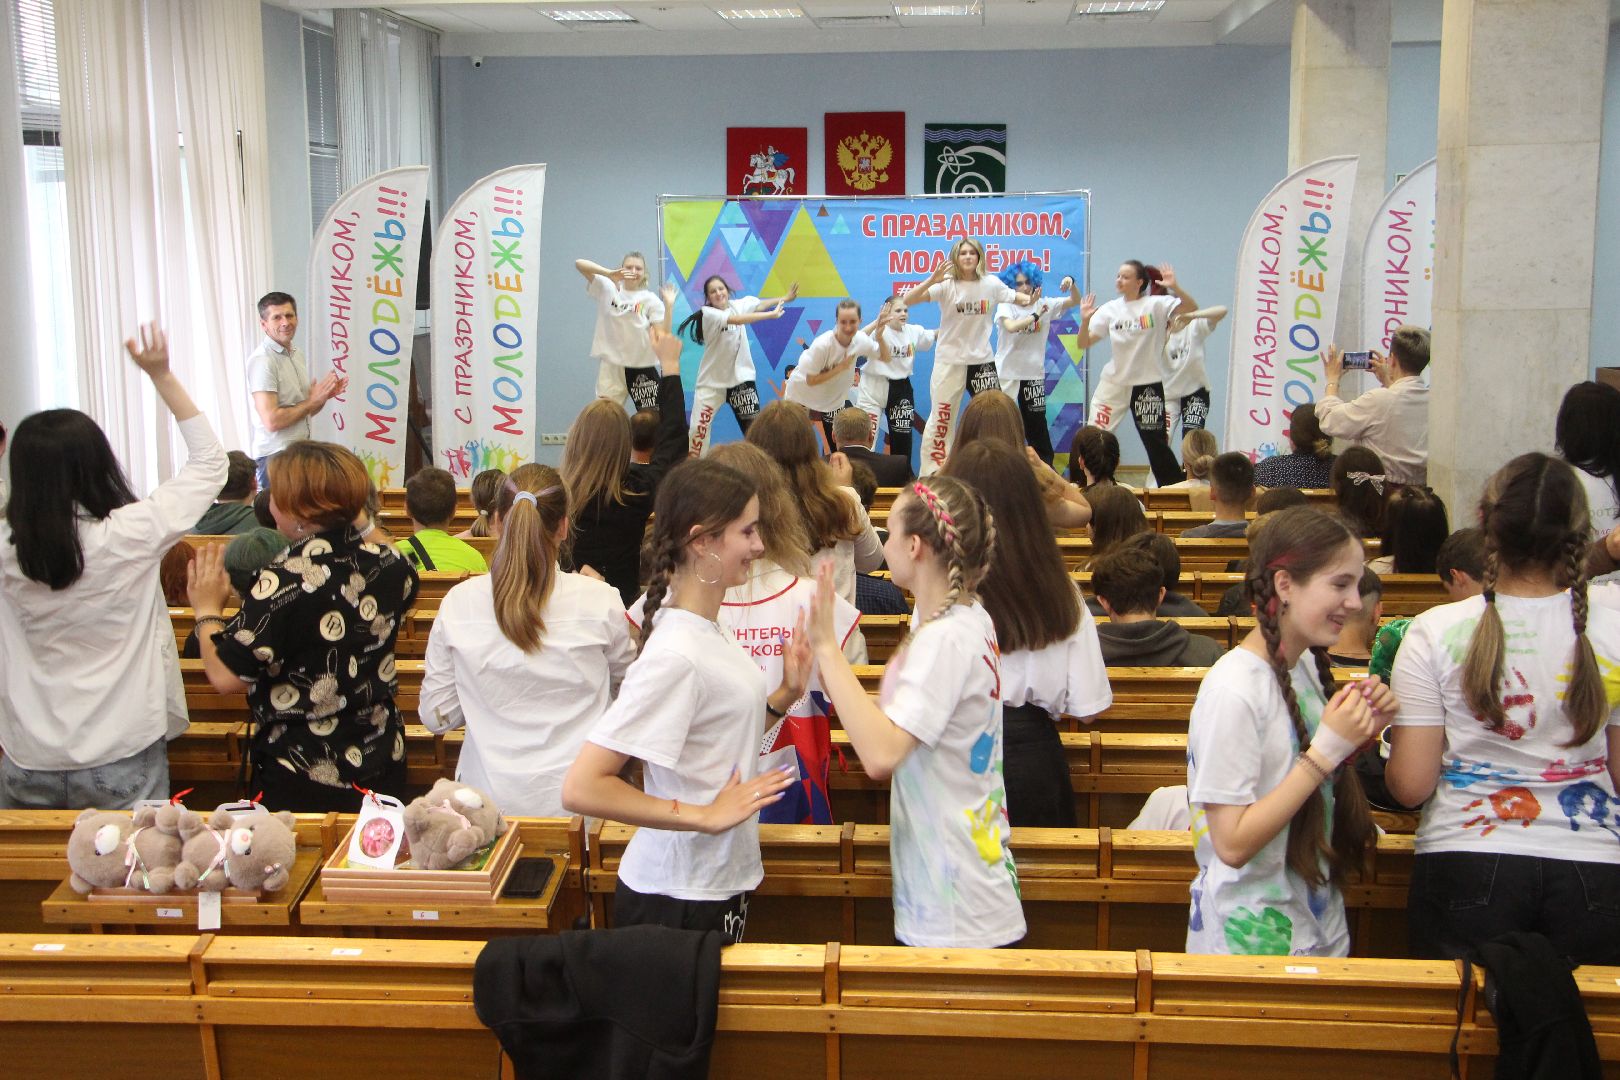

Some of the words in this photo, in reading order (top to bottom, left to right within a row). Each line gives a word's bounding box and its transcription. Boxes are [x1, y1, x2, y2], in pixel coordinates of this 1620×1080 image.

[862, 213, 876, 237] С
[882, 212, 1071, 240] ПРАЗДНИКОМ,
[889, 244, 1050, 274] МОЛЁЖЬ!
[329, 211, 361, 402] АЗДНИКОМ,
[454, 211, 479, 397] ПРАЗДНИКОМ,
[1252, 204, 1288, 397] ПРАЗДНИКОМ,
[1282, 178, 1335, 438] ОЛОДЁЖЬ!!!
[454, 405, 473, 425] С
[1249, 407, 1270, 426] С
